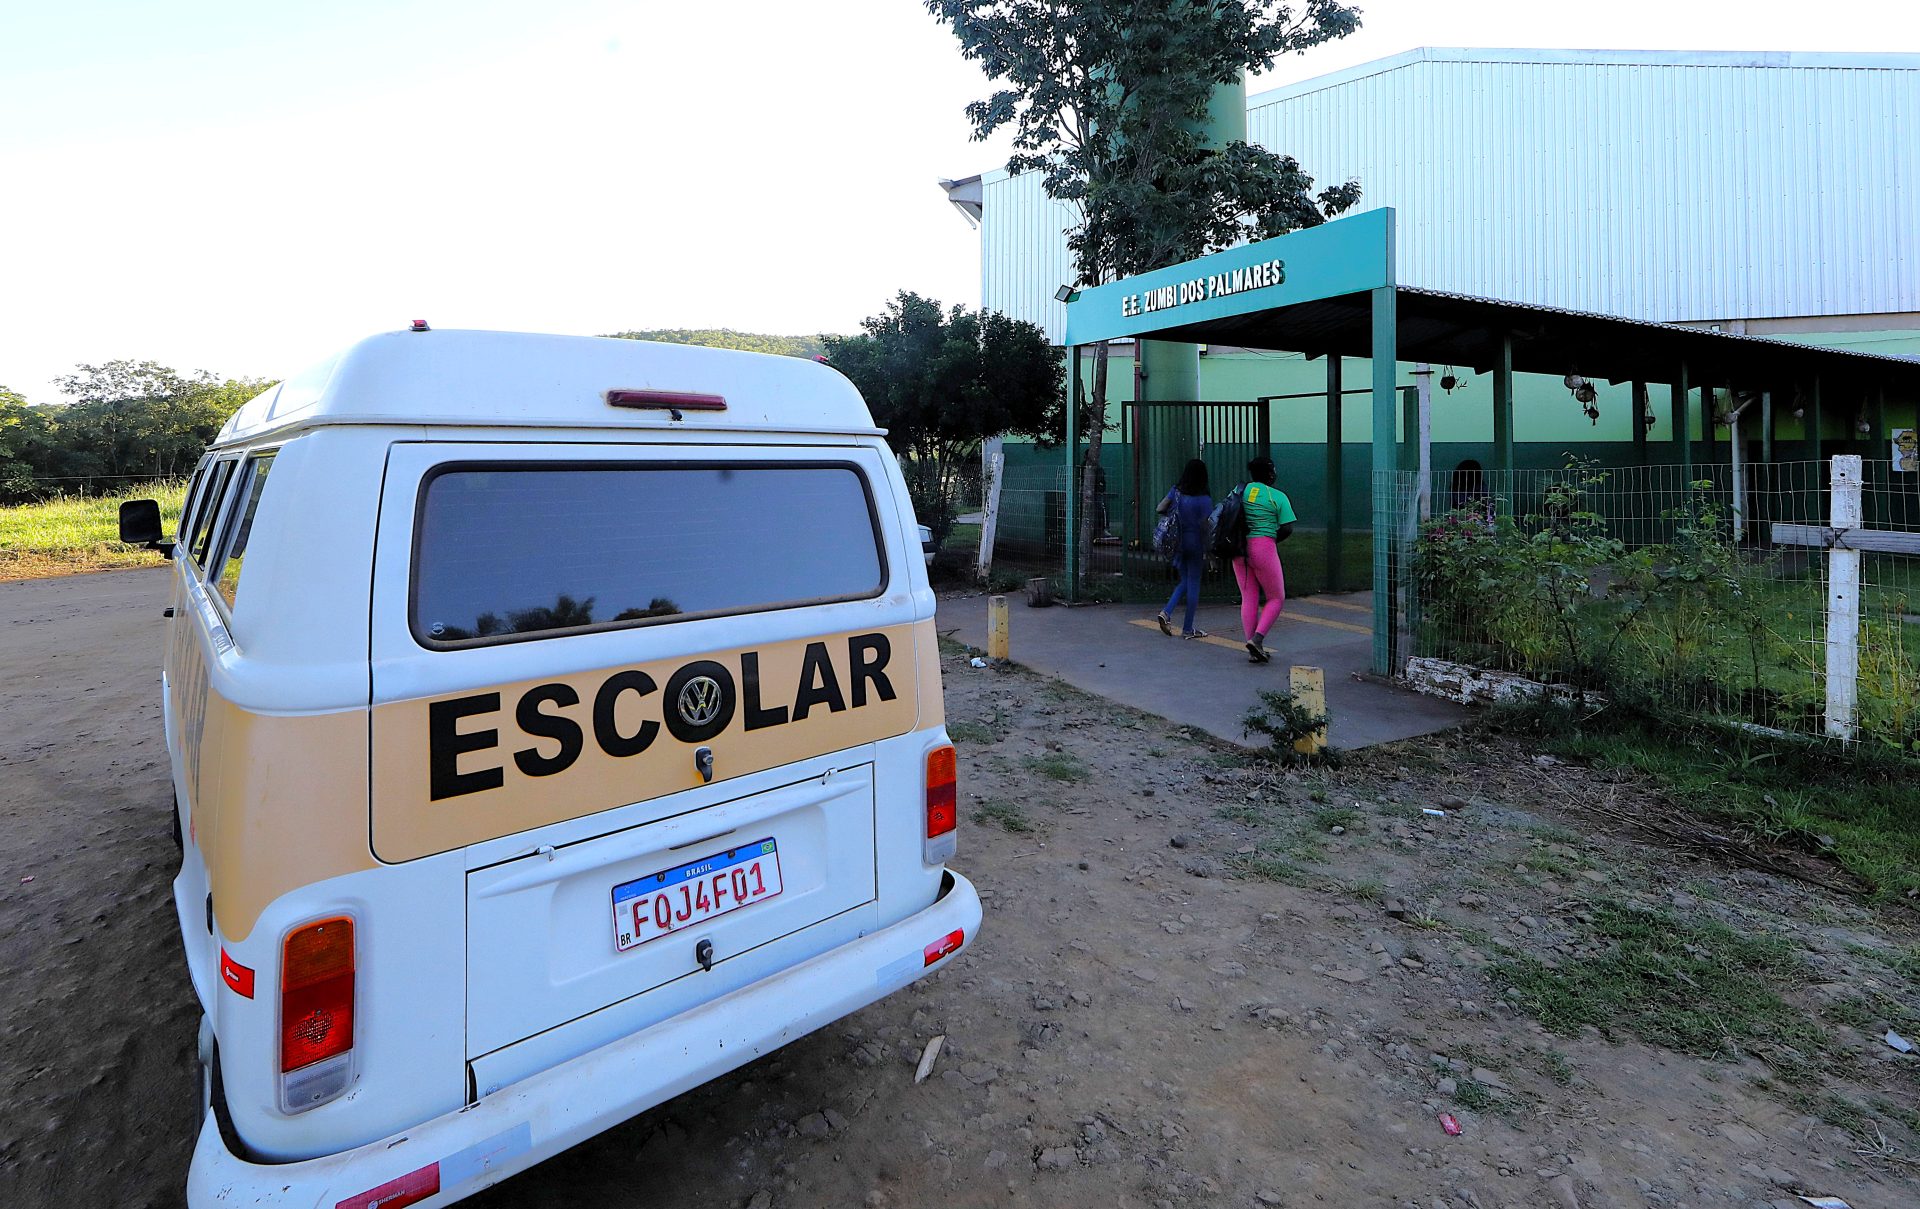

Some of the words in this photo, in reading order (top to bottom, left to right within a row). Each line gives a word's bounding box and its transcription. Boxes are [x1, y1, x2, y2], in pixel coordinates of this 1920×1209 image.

[1122, 294, 1141, 317] E.E.
[1144, 284, 1177, 313] ZUMBI
[1180, 278, 1204, 304] DOS
[1208, 259, 1281, 298] PALMARES
[429, 632, 897, 801] ESCOLAR
[685, 863, 713, 878] BRASIL
[620, 932, 632, 947] BR
